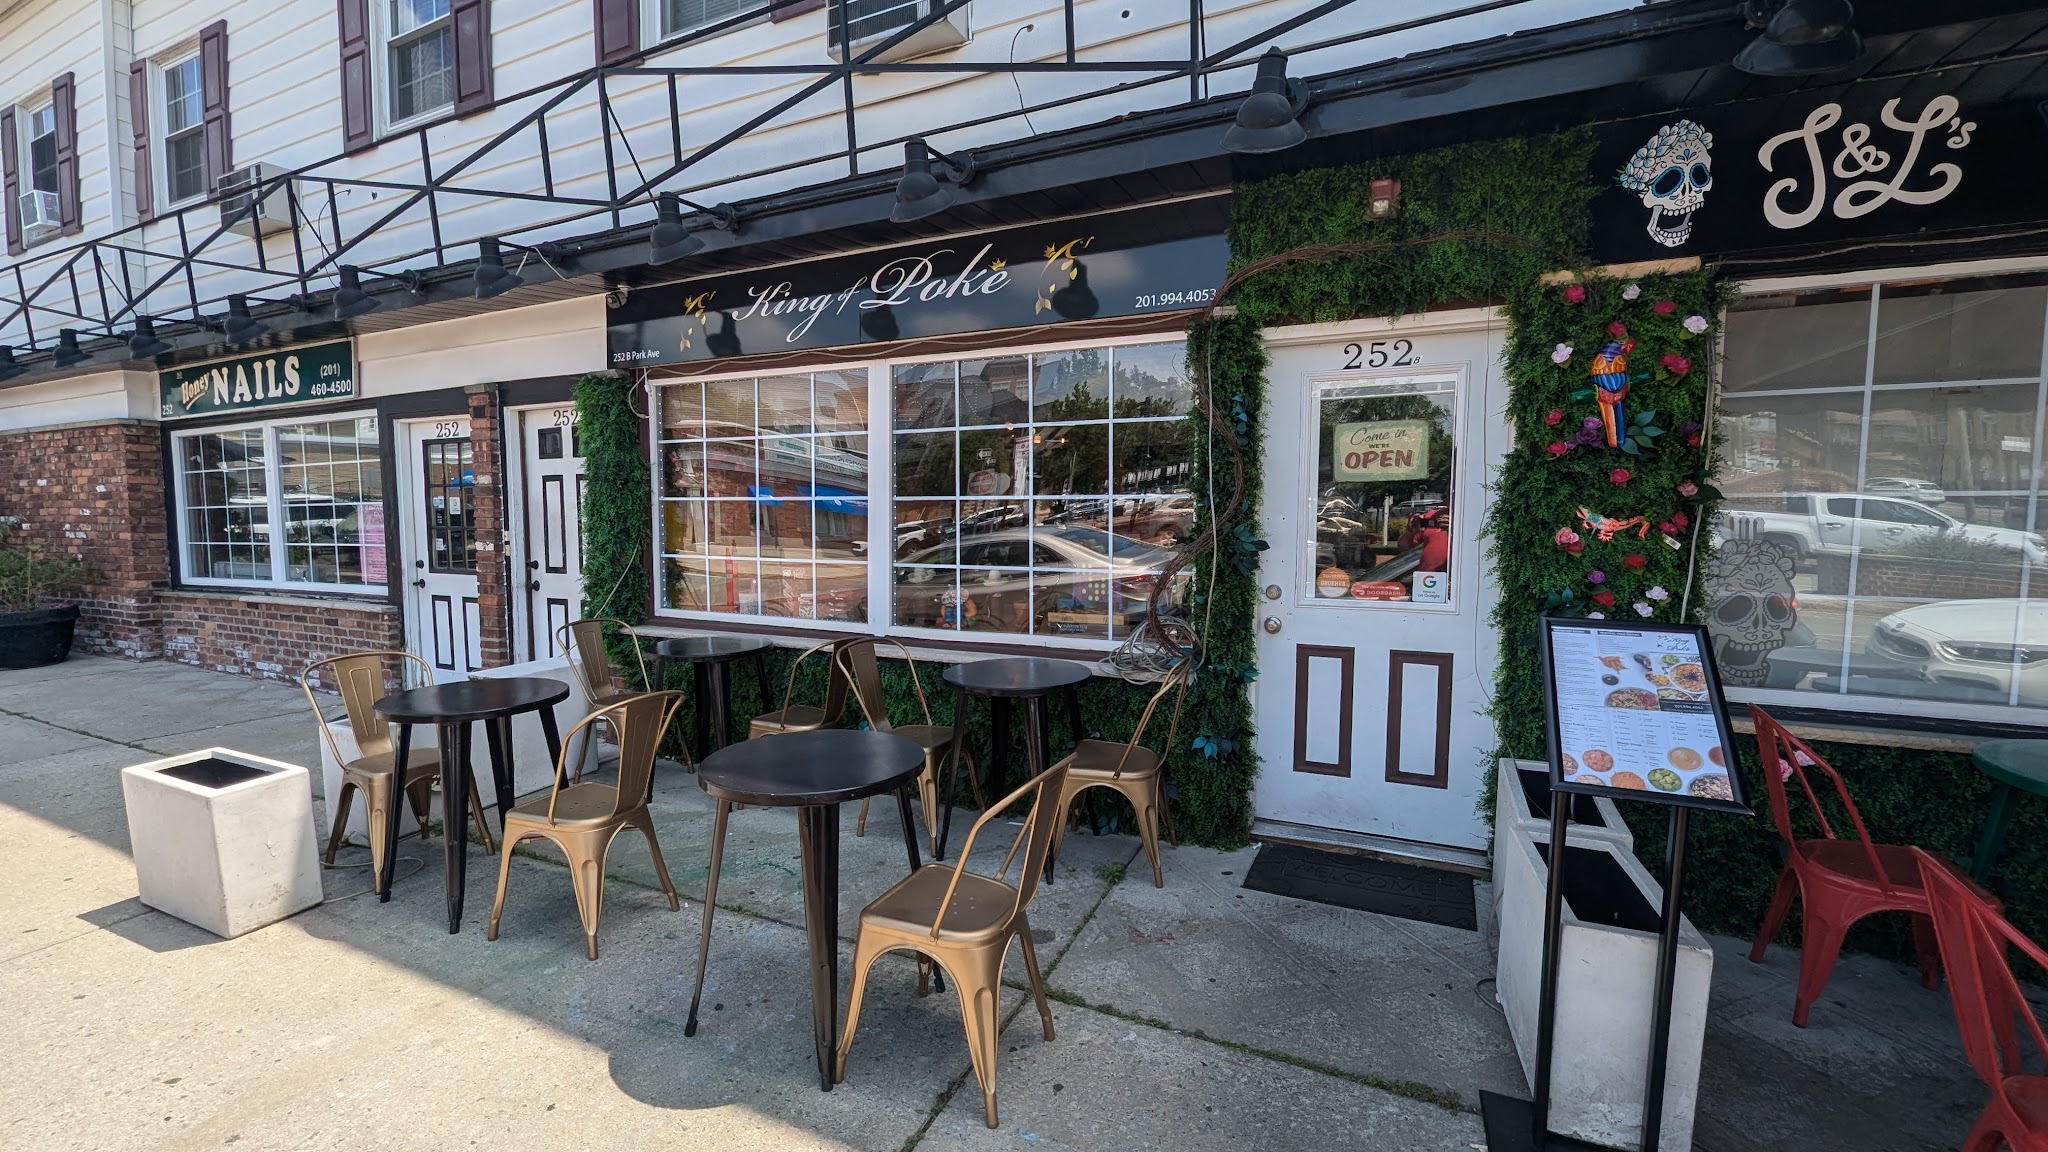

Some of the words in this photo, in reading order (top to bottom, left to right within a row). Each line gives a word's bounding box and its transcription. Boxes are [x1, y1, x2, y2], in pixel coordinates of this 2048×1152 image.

[1758, 95, 1977, 229] J&L's
[732, 281, 834, 342] King
[837, 276, 867, 315] of
[859, 243, 1012, 309] Poke
[1135, 288, 1217, 308] 201.994.4053
[613, 353, 626, 363] 252
[626, 351, 631, 361] B
[632, 350, 646, 360] Park
[647, 349, 660, 359] Ave
[1342, 339, 1413, 370] 252
[1413, 356, 1421, 364] B
[211, 355, 300, 406] NAILS
[320, 363, 341, 378] (201)
[181, 372, 210, 404] Honey
[311, 379, 352, 396] 460-4500
[162, 404, 173, 415] 252
[553, 409, 579, 426] 252
[436, 422, 460, 437] 252
[1350, 427, 1390, 446] Come
[1394, 428, 1406, 439] in
[1344, 449, 1414, 470] OPEN
[1293, 863, 1435, 896] WELCOME
